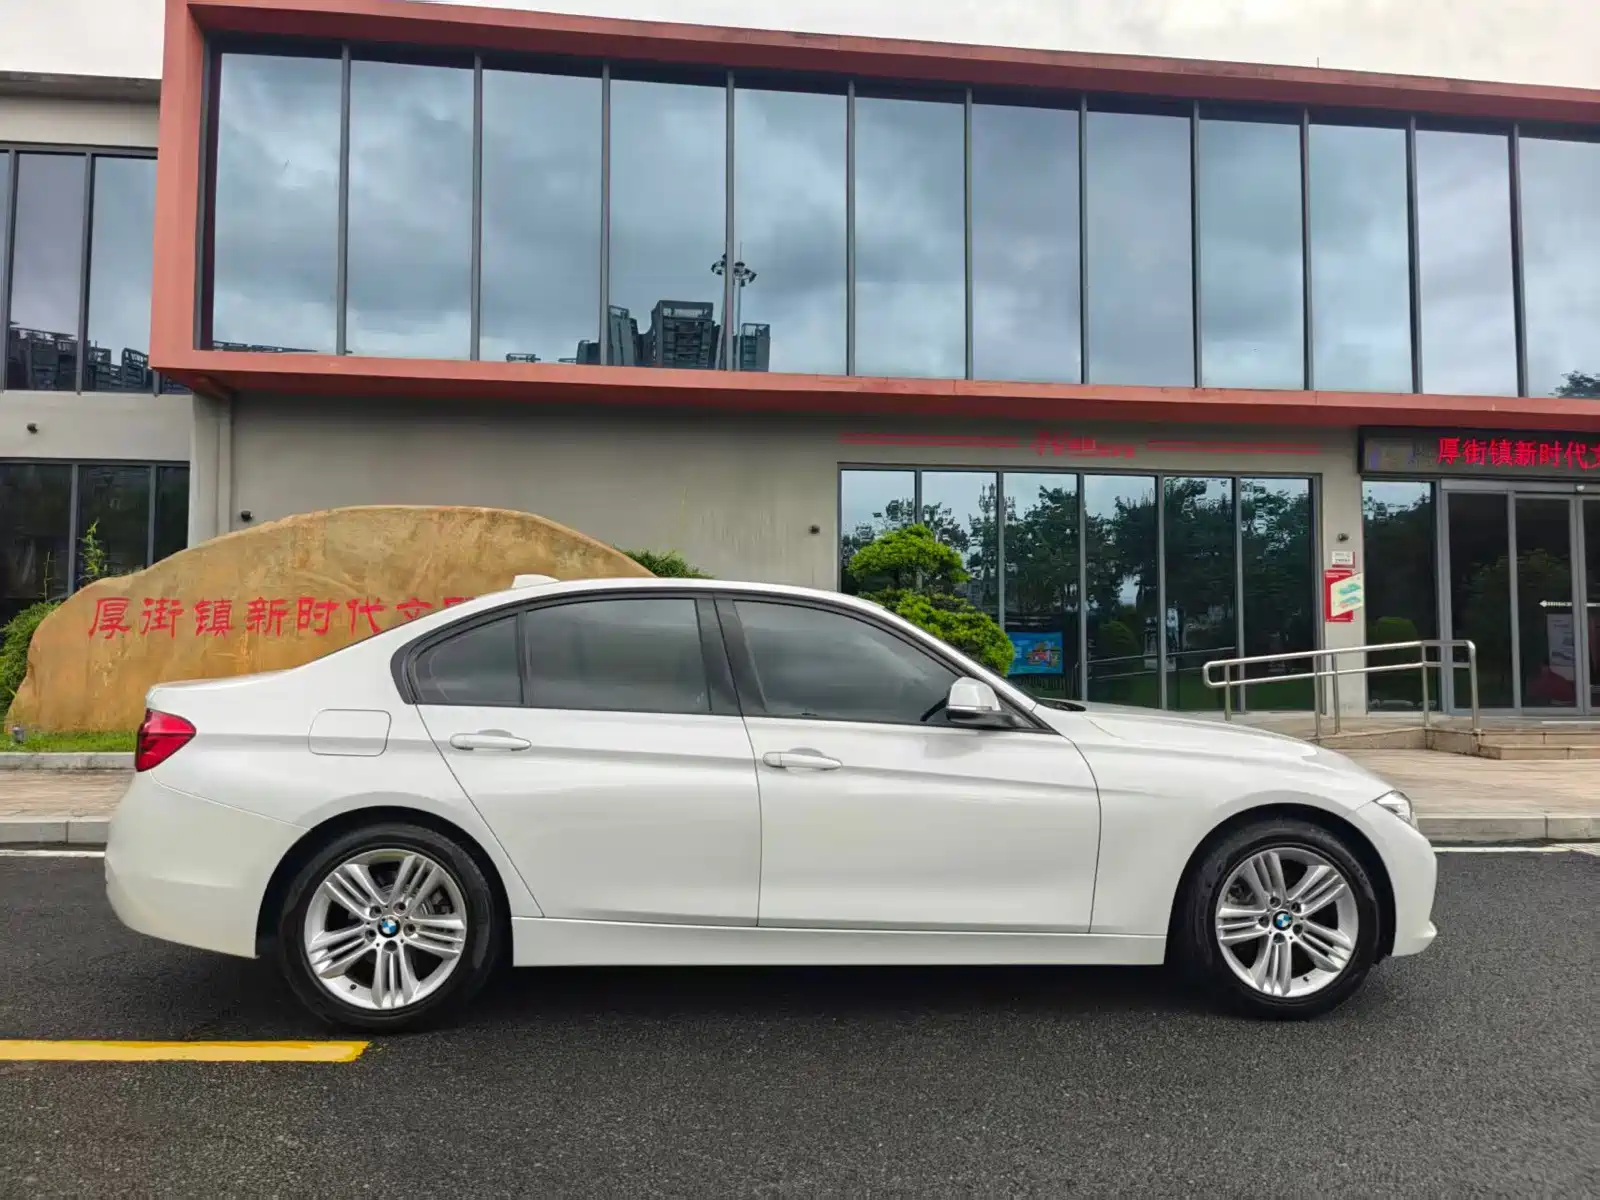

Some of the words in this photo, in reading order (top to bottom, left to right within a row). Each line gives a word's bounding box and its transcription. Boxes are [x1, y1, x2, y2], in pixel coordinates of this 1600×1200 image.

[88, 596, 475, 640] 厚街镇新时代文
